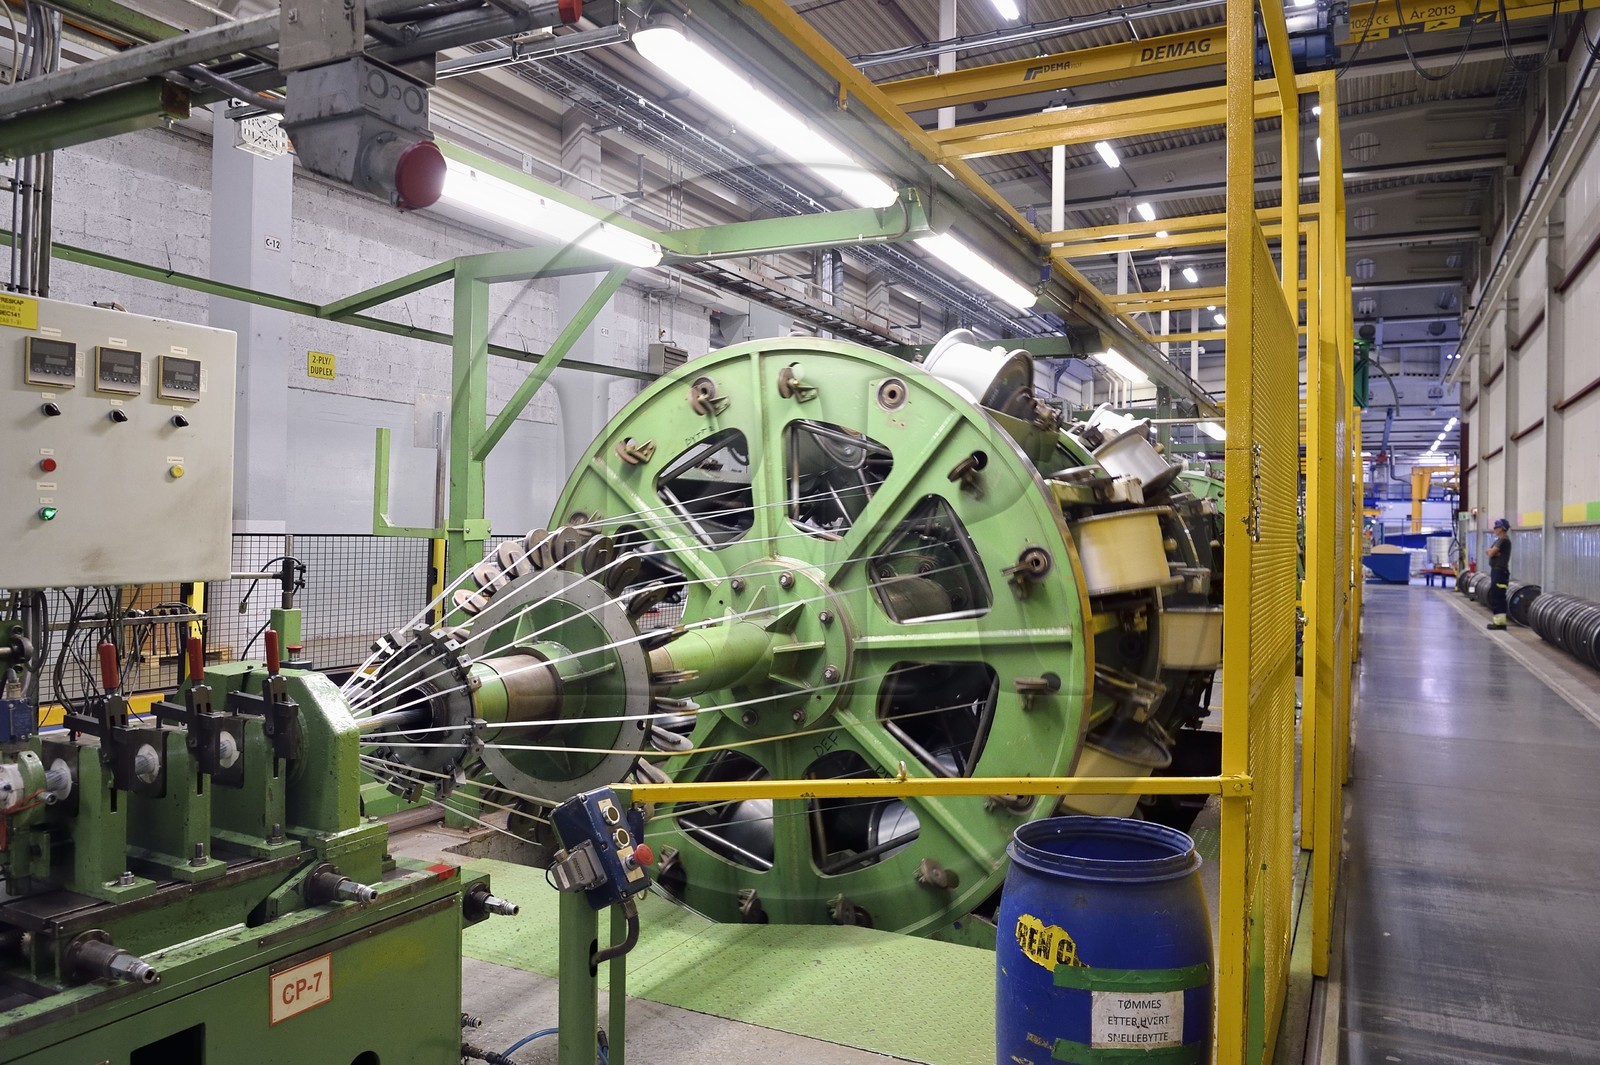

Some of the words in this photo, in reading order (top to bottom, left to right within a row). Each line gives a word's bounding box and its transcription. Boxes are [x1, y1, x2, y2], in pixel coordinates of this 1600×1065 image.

[1410, 6, 1426, 20] År
[1427, 5, 1456, 18] 2013
[1140, 38, 1211, 63] DEMAG
[265, 238, 280, 249] C-12
[312, 355, 331, 365] 2-PLY/
[310, 365, 333, 377] DUPLEX
[282, 971, 322, 1005] CP-7
[1117, 999, 1162, 1010] TØMMES
[1107, 1015, 1137, 1026] ETTER
[1140, 1015, 1170, 1026] HVERT
[1107, 1032, 1169, 1043] SNELLEBYTTE
